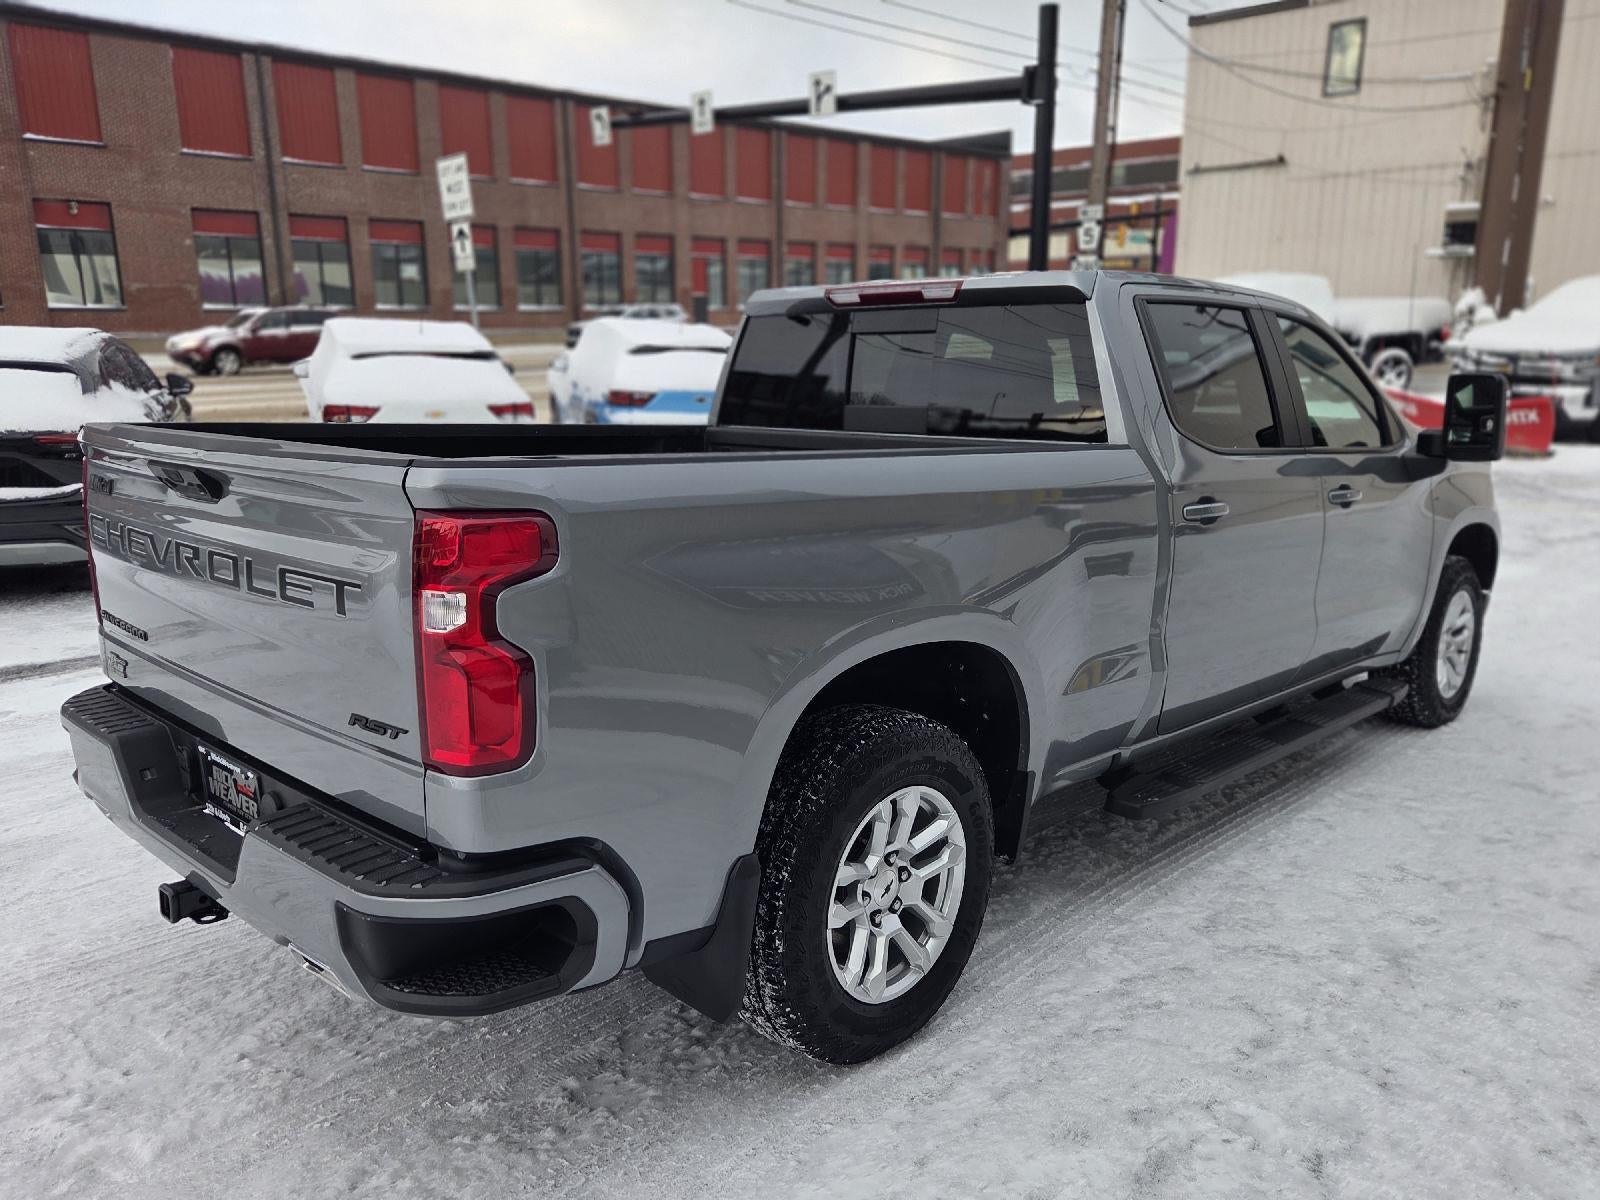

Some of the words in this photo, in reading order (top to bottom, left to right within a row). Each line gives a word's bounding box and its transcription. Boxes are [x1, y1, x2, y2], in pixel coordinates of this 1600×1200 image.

[88, 512, 362, 619] CHEVROLET
[347, 712, 410, 740] RST
[212, 765, 237, 788] RICK
[208, 776, 258, 819] WEAVER
